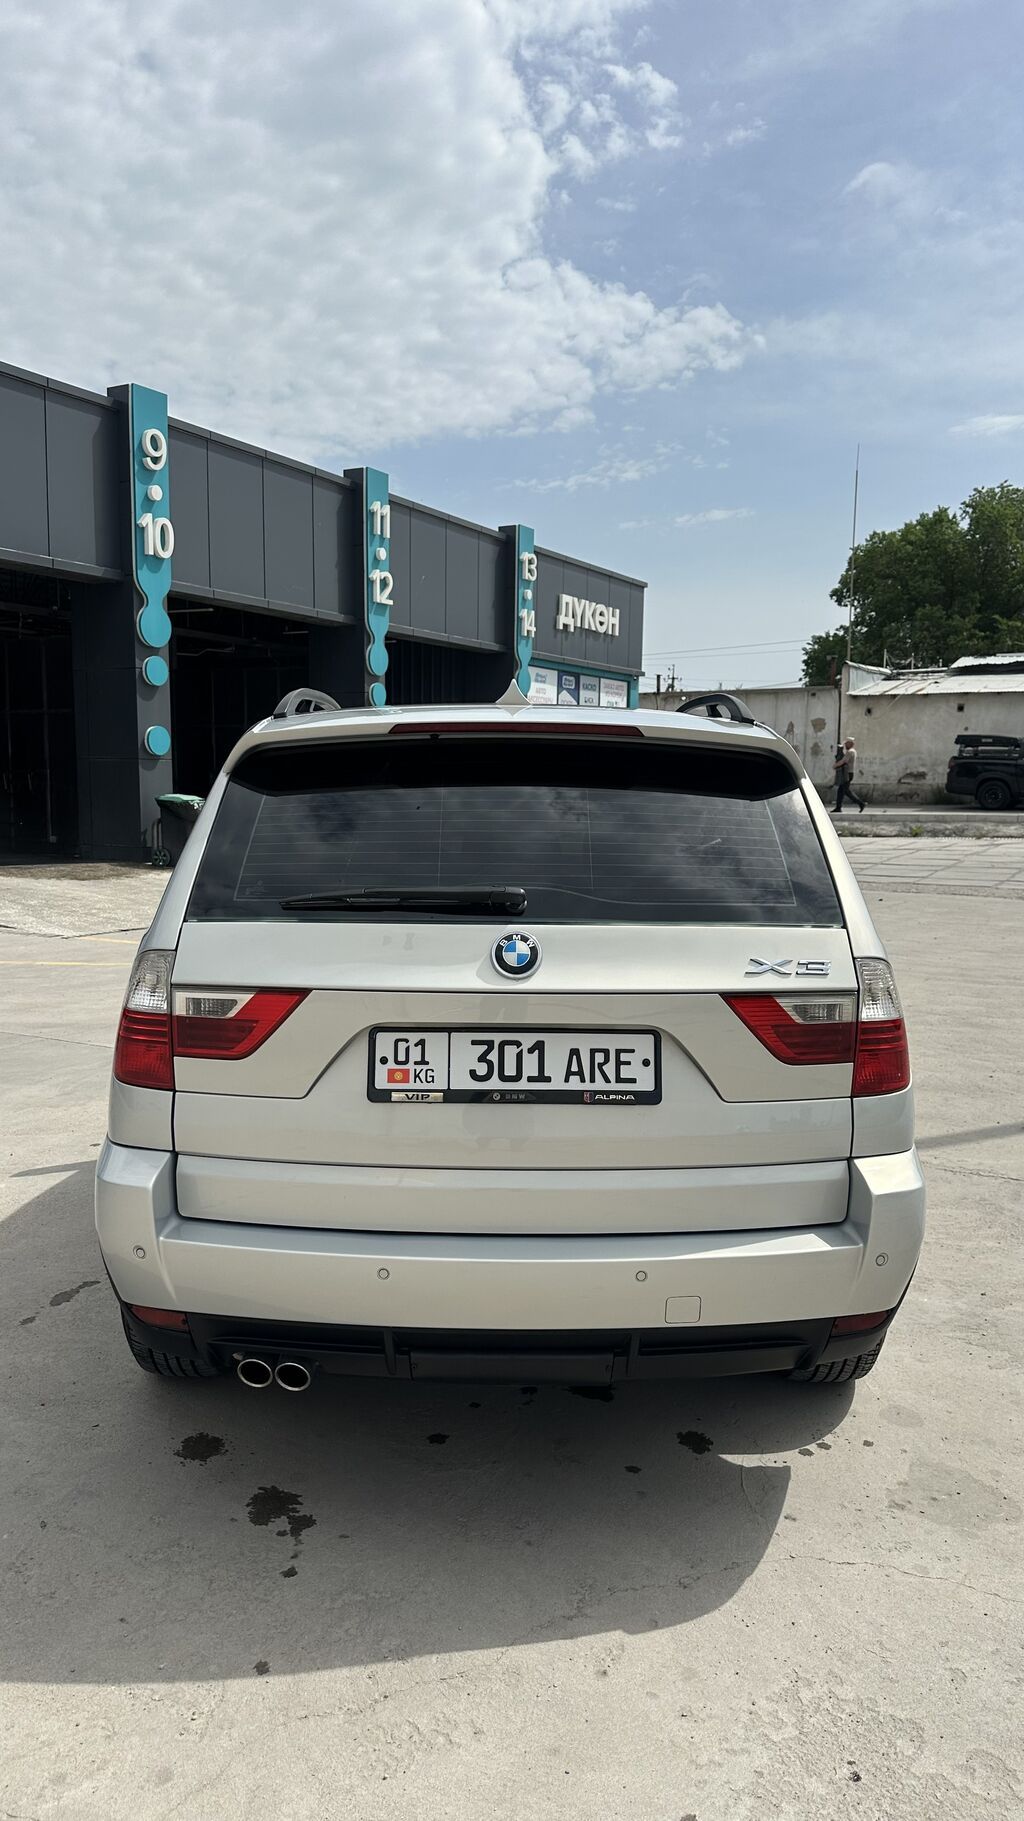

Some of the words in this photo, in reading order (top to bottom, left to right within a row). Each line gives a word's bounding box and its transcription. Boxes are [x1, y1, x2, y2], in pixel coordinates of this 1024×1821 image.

[142, 428, 167, 471] 9
[369, 501, 390, 538] 11
[137, 512, 175, 559] 10
[519, 552, 537, 581] 13
[369, 569, 394, 605] 12
[519, 608, 537, 638] 14
[499, 934, 535, 948] BMW
[744, 957, 832, 976] X3
[393, 1038, 430, 1066] 01
[468, 1039, 552, 1083] 301
[563, 1048, 637, 1084] ARE
[413, 1068, 435, 1084] KG
[404, 1093, 431, 1101] VIP
